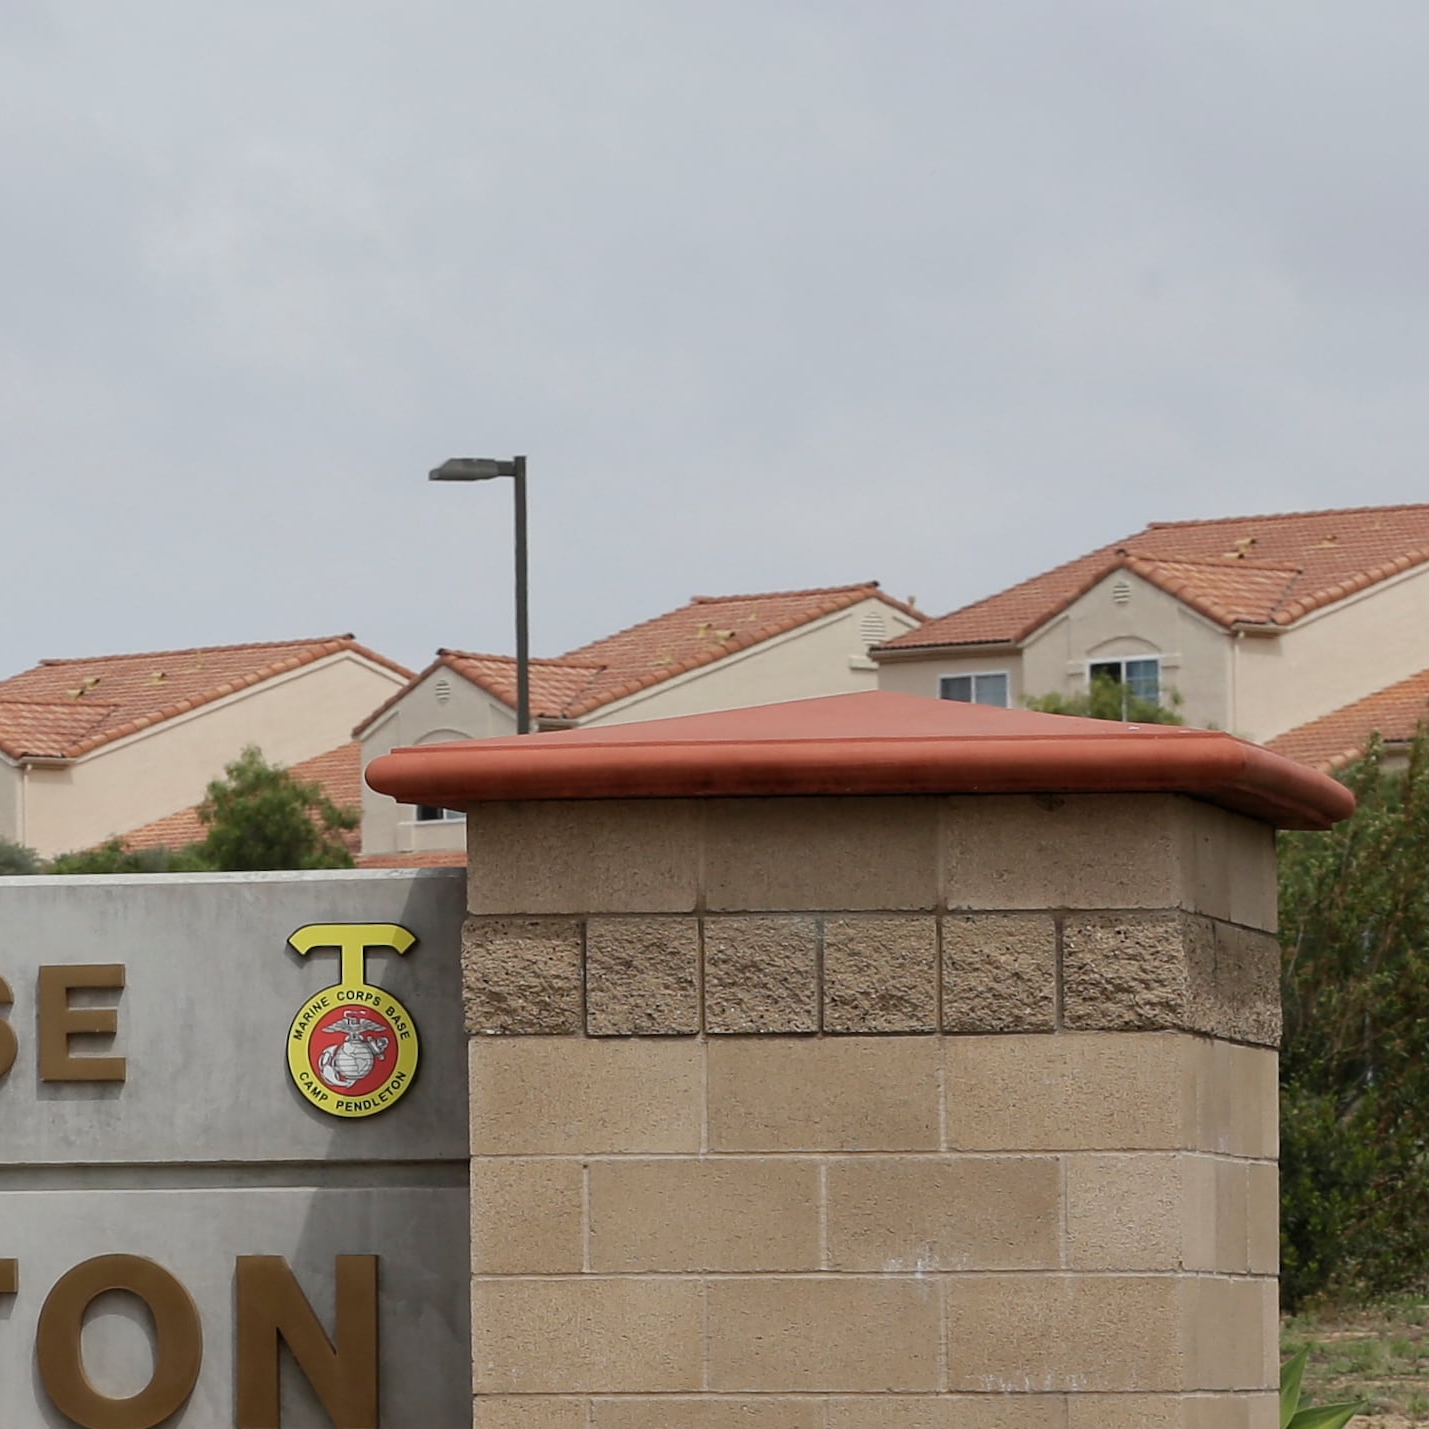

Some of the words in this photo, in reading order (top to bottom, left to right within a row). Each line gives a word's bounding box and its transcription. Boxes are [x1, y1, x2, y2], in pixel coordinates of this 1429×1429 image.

[294, 997, 329, 1041] MARINE
[337, 991, 381, 1006] CORPS
[386, 1006, 410, 1040] BASE
[299, 1072, 328, 1102] CAMP
[336, 1071, 407, 1112] PENDLETON
